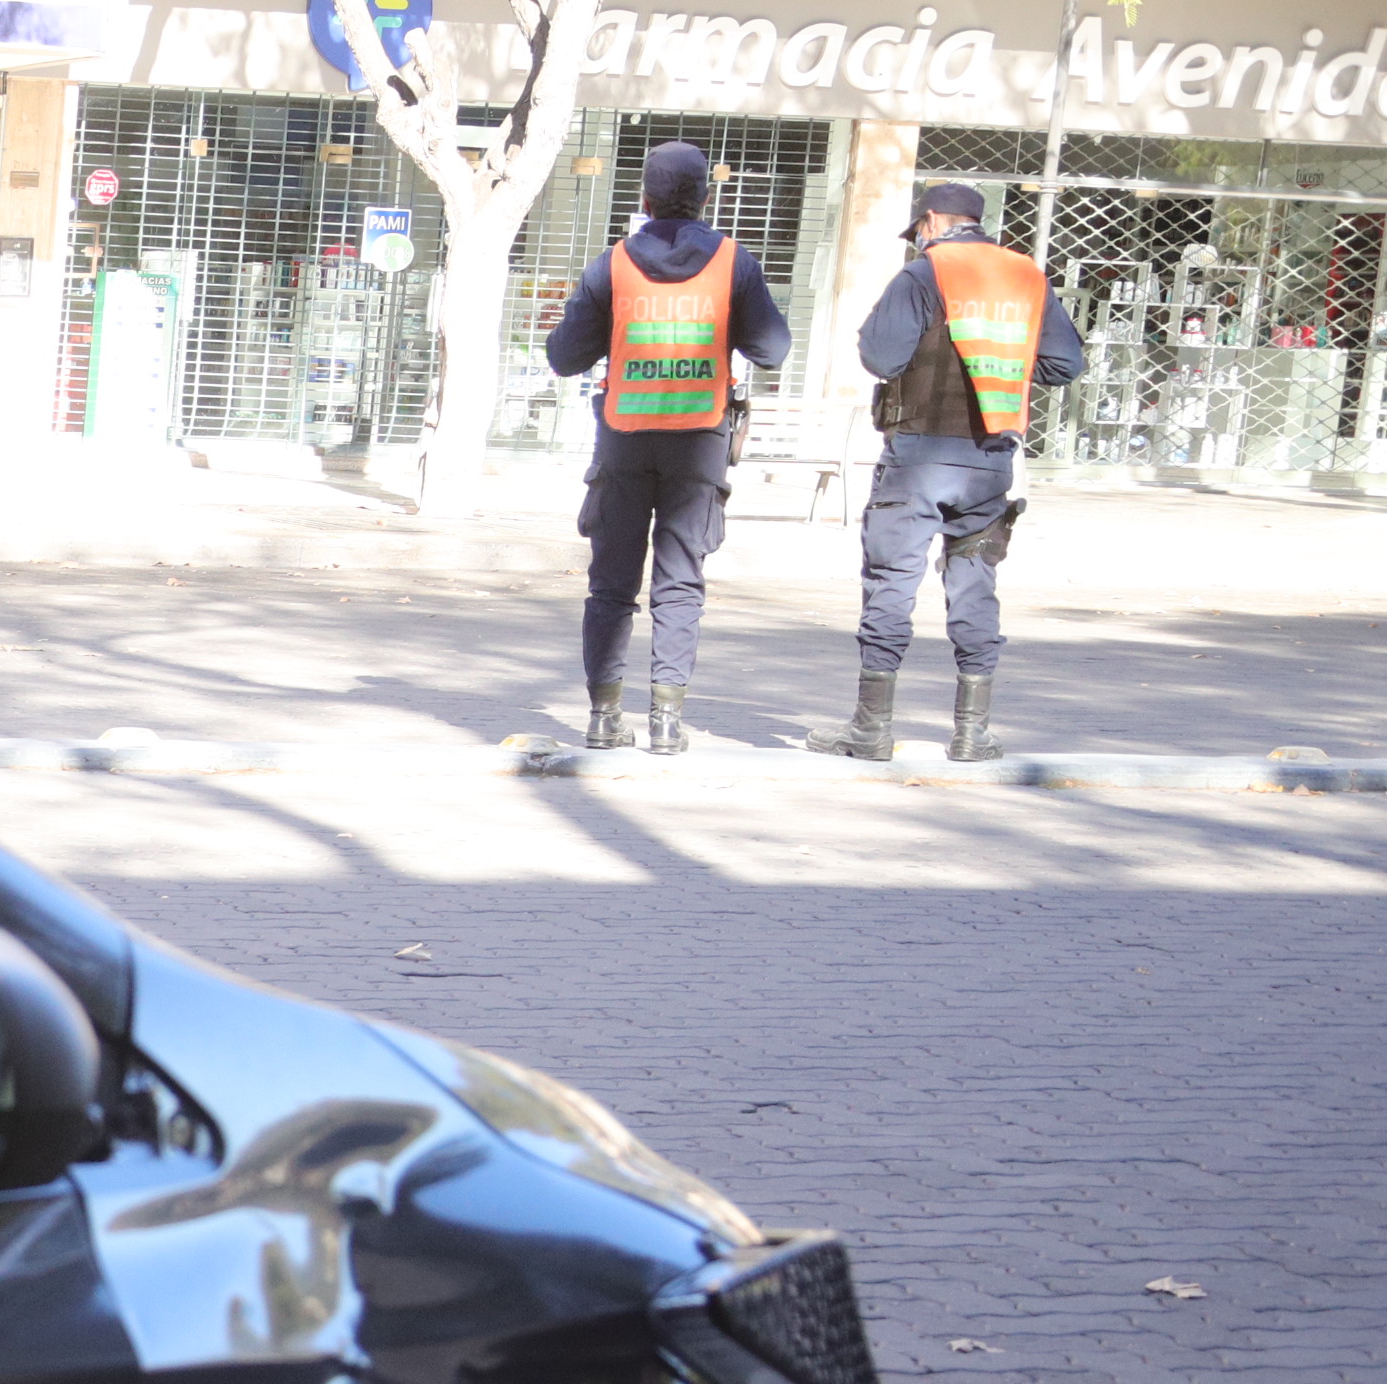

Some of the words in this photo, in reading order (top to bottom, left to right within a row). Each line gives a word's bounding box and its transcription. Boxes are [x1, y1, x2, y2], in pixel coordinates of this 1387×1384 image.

[517, 3, 996, 98] armacia
[1028, 15, 1387, 119] Avenid
[368, 214, 406, 231] PAMI
[139, 276, 172, 286] ACIAS
[147, 286, 169, 296] RNO
[617, 294, 717, 321] POLICIA
[626, 359, 714, 380] POLICIA
